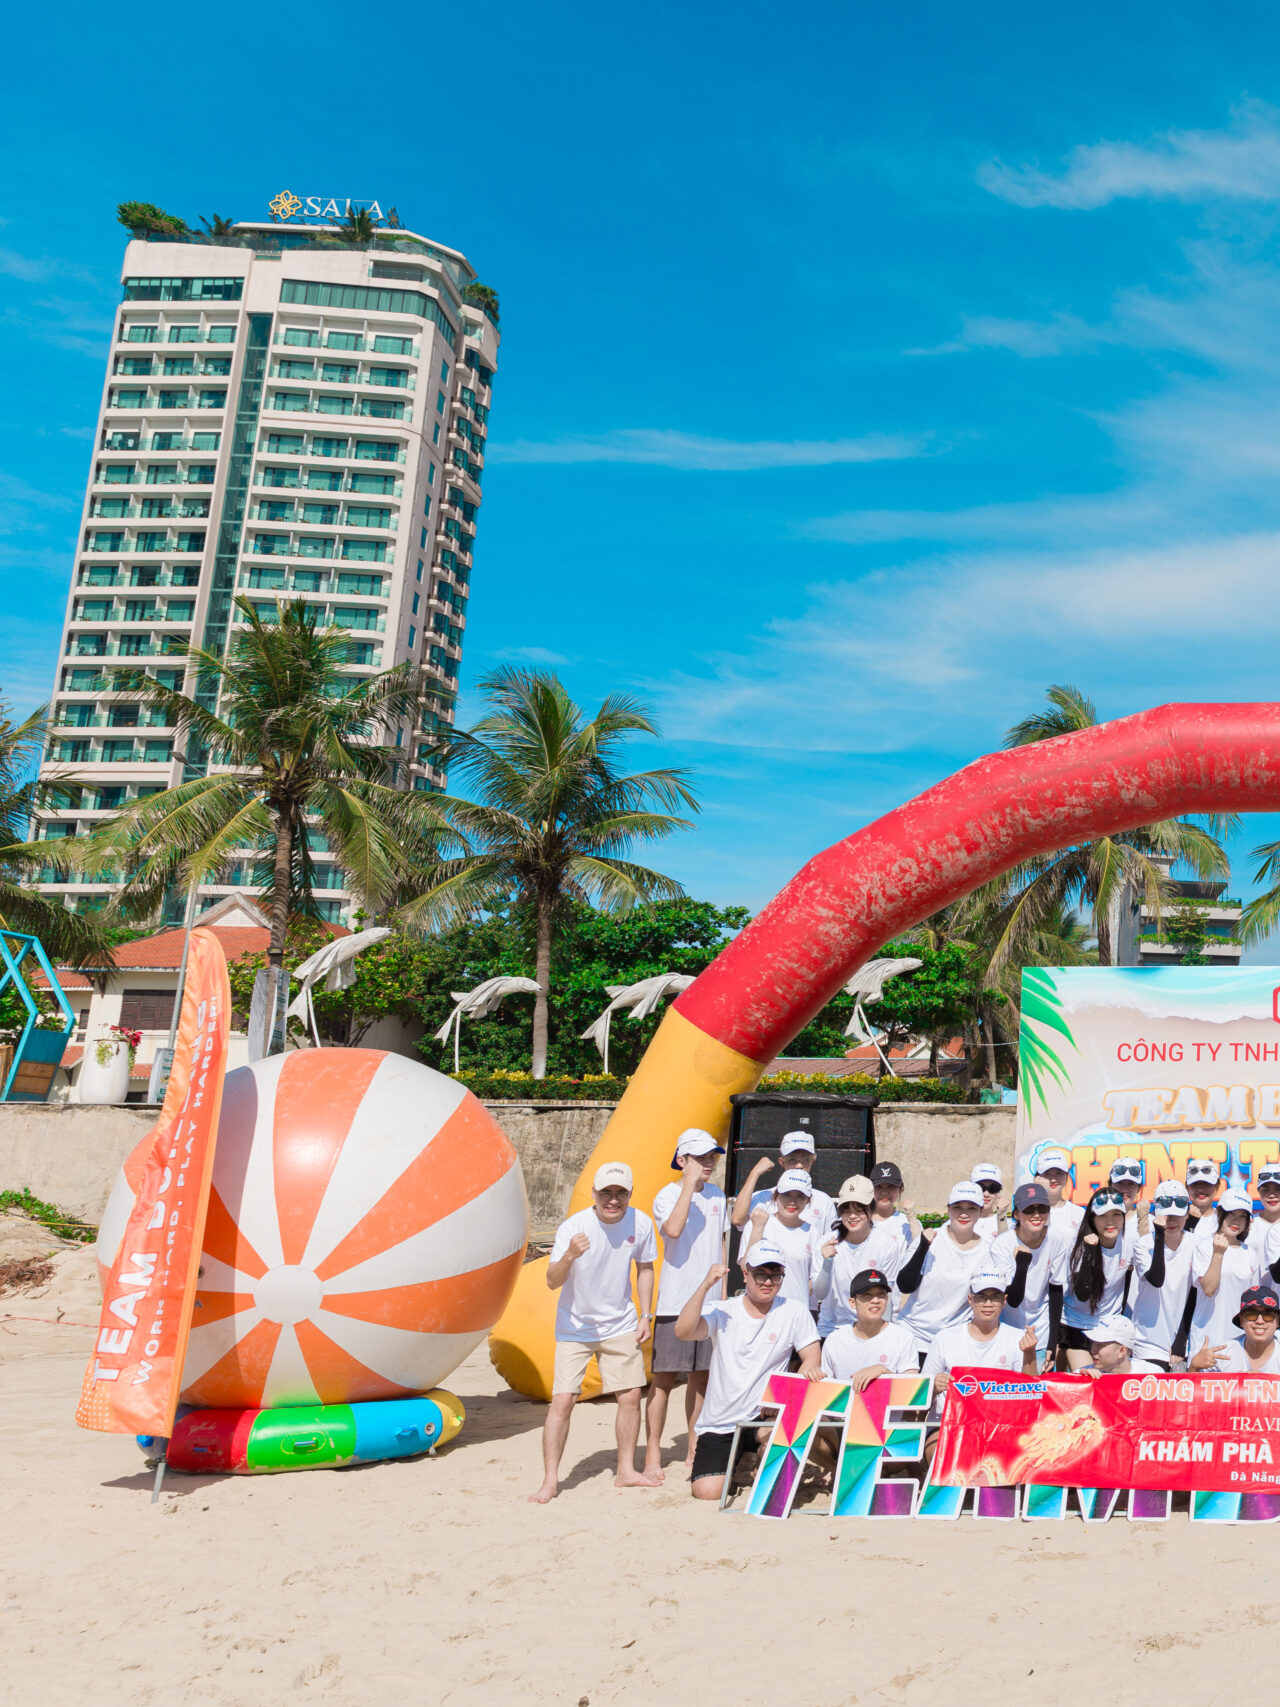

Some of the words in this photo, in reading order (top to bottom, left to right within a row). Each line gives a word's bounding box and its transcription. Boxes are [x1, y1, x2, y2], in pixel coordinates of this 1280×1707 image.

[1117, 1037, 1184, 1062] CÔNG
[1192, 1042, 1222, 1062] TY
[1103, 1085, 1254, 1132] TEAM
[131, 1299, 165, 1386] WORK
[177, 1120, 196, 1187] PLAY
[193, 996, 217, 1108] HARDER!
[92, 1252, 159, 1388] TEAM
[978, 1381, 1047, 1394] Vietravel
[1121, 1375, 1195, 1402] CÔNG
[1200, 1379, 1238, 1403] TY
[1138, 1436, 1214, 1462] KHÁM
[1222, 1438, 1274, 1464] PHÀ
[1230, 1471, 1247, 1482] Đà
